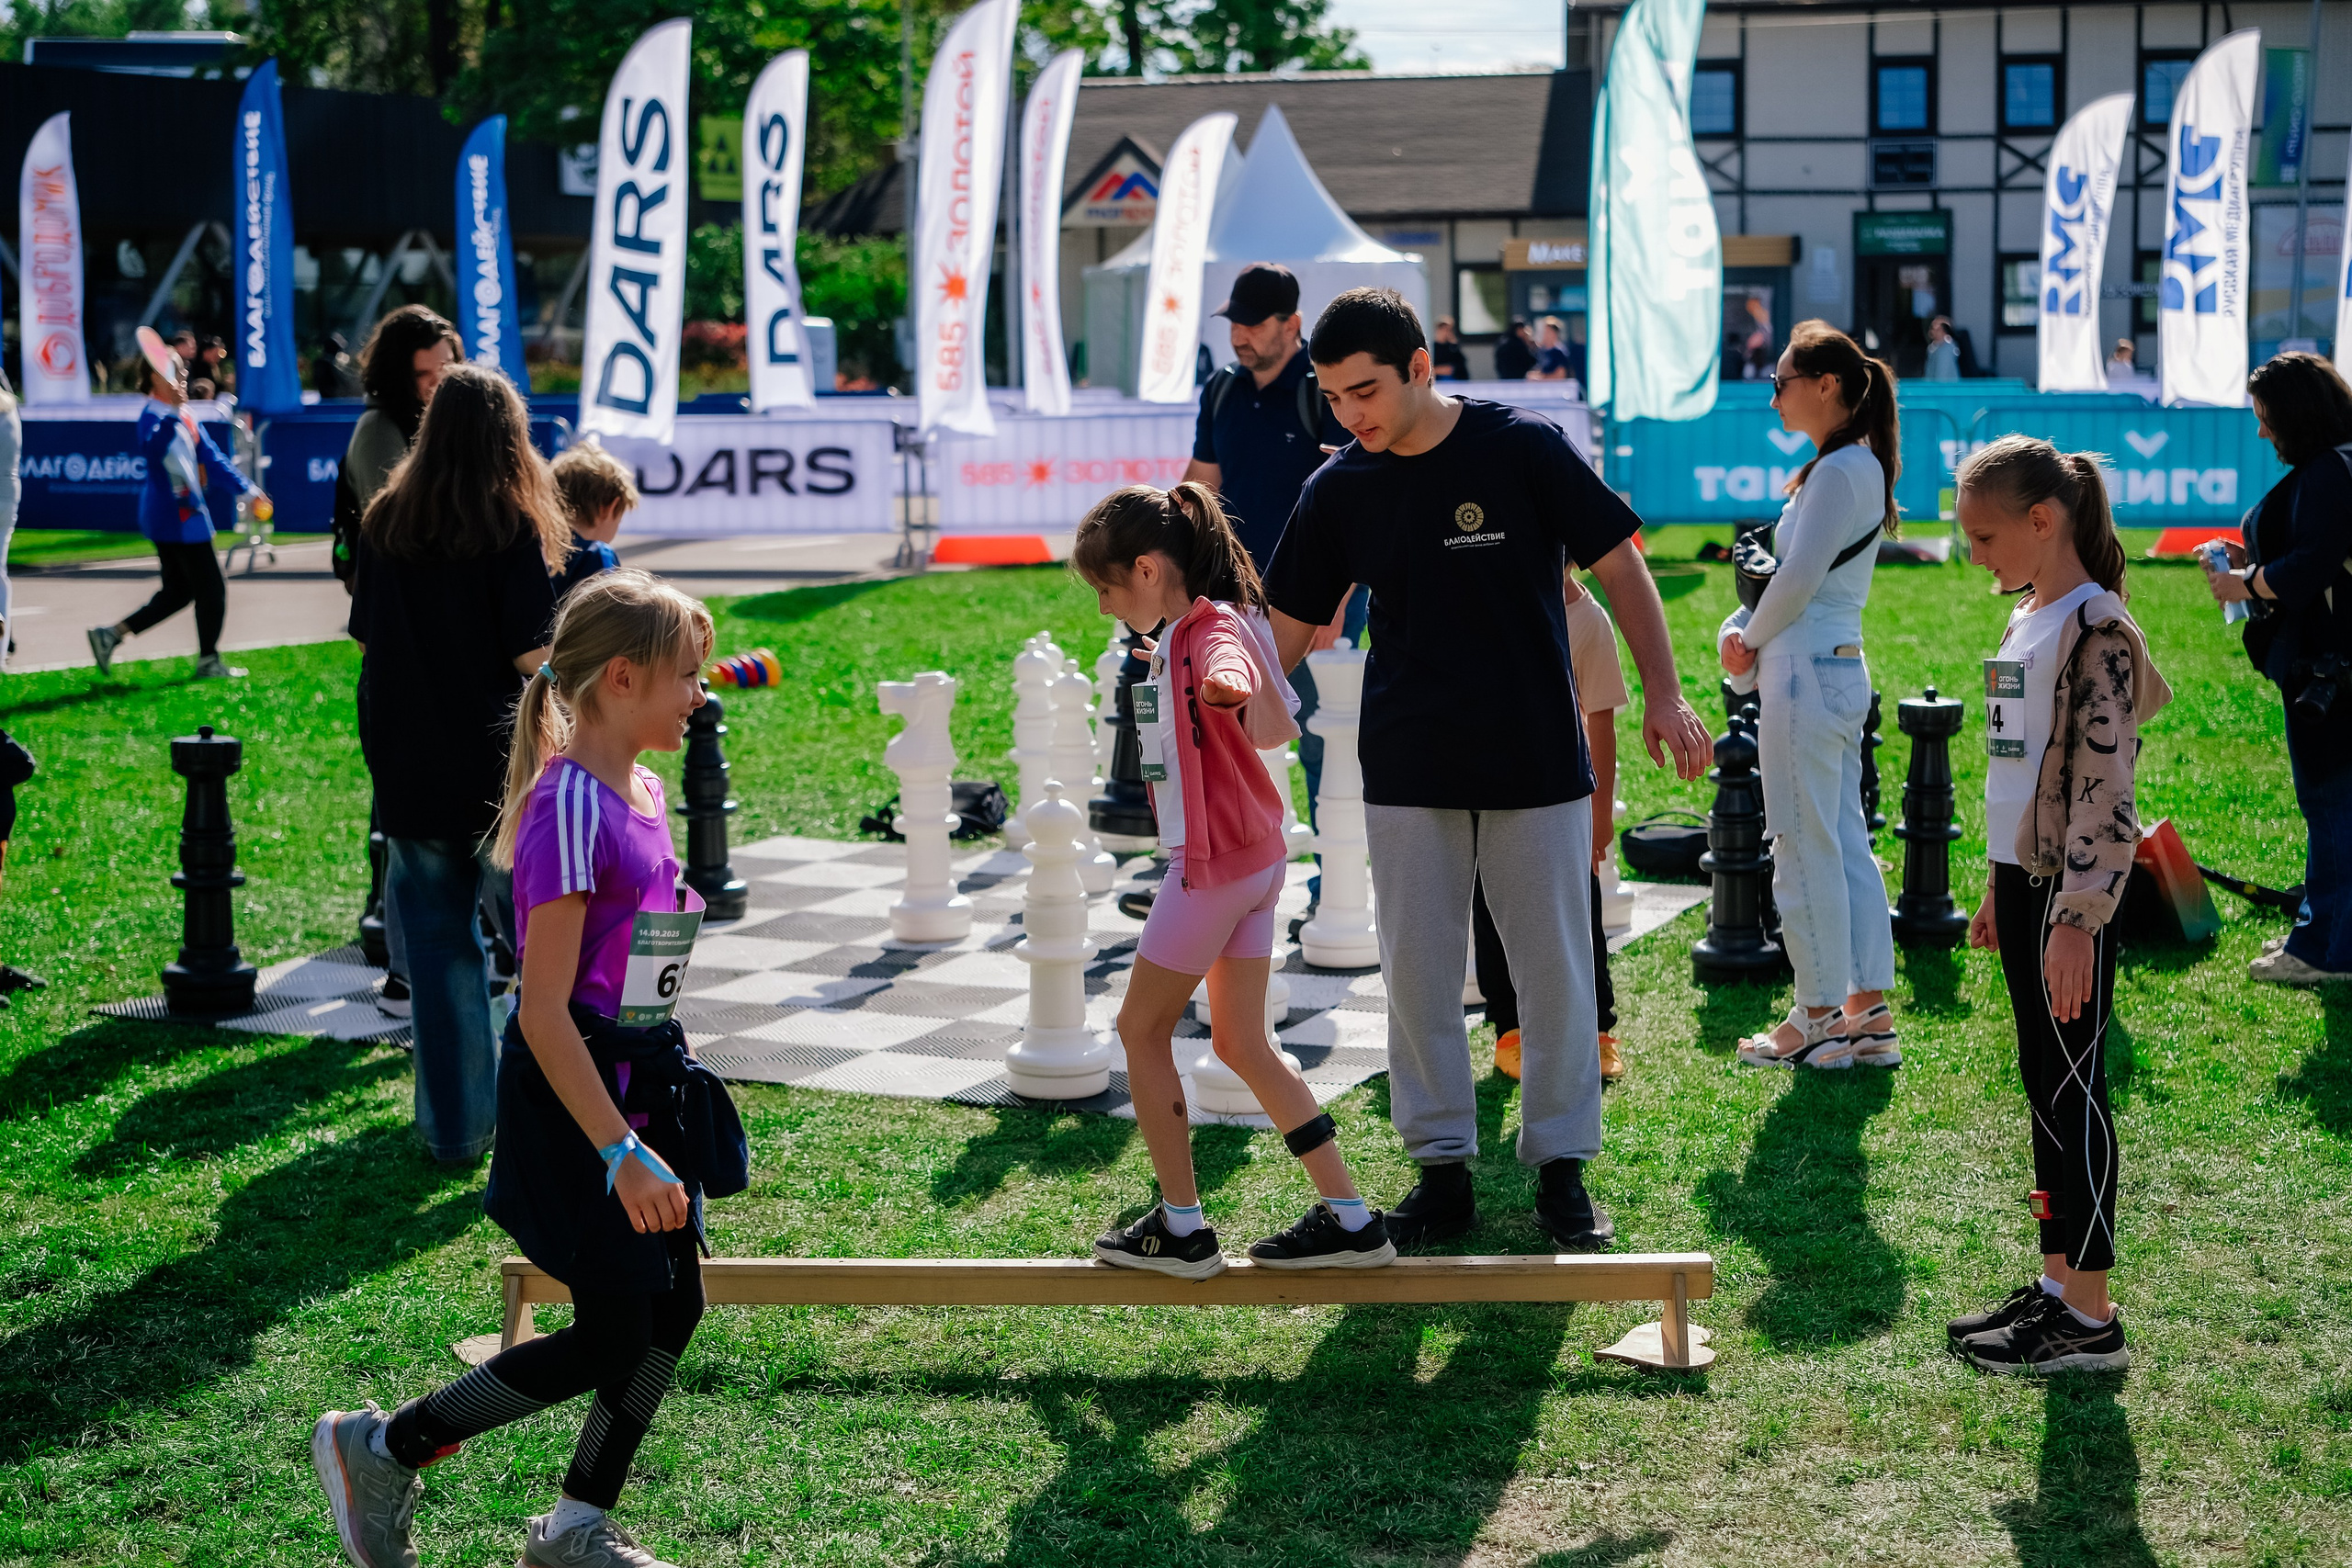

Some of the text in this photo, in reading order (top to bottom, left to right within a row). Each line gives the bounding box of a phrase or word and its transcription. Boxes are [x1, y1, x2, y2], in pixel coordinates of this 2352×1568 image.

[32, 165, 77, 331] ДОБРОДОМИК
[243, 109, 267, 367] БЛАГОДЕЙСТВИЕ
[596, 96, 671, 416] DARS
[2045, 165, 2088, 315] RMG
[2162, 123, 2223, 315] RMG
[636, 446, 856, 497] DARS
[1443, 532, 1506, 547] БЛАГОДЕЙСТВИЕ
[639, 929, 681, 938] 14.09.2025
